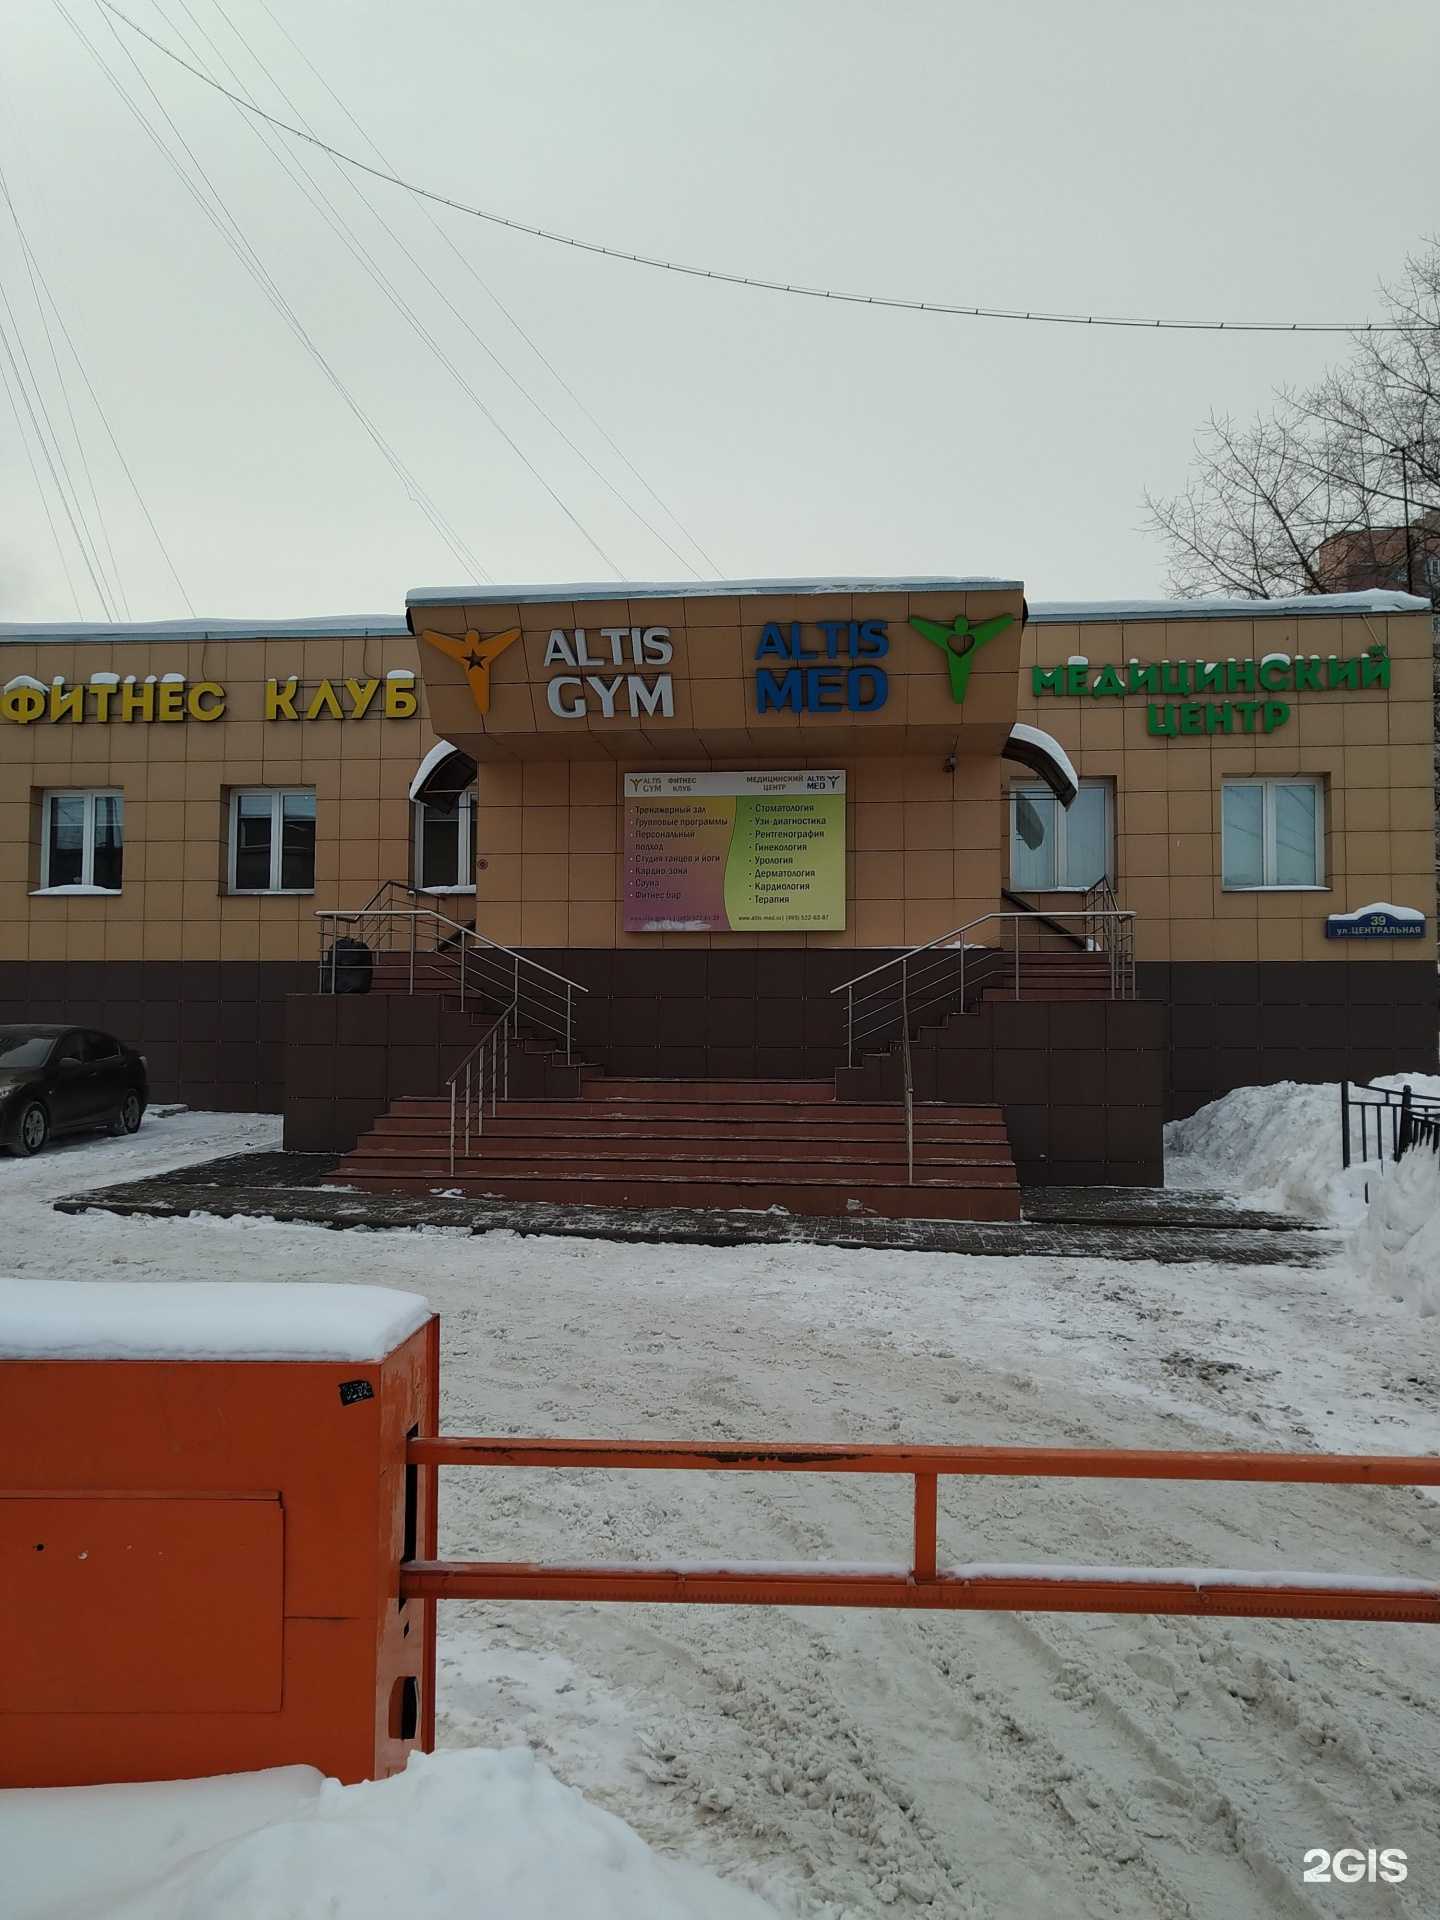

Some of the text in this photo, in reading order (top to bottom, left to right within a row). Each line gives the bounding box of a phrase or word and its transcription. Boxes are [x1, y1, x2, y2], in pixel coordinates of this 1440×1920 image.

[754, 619, 890, 661] ALTIS
[543, 626, 674, 668] ALTIS
[1032, 644, 1392, 699] МЕДИЦИНСКИЙ
[756, 666, 890, 714] MED
[1, 676, 419, 725] ФИТНЕС КЛУБ
[546, 672, 675, 719] GYM
[1146, 700, 1291, 738] ЦЕНТР
[807, 782, 826, 790] MED
[755, 803, 814, 813] Стоматология
[755, 830, 825, 840] Рентгенография
[755, 843, 807, 851] Гинекология
[754, 856, 794, 866] Урология
[754, 869, 816, 879] Дерматология
[754, 882, 810, 892] Кардиология
[754, 895, 790, 904] Терапия
[1370, 915, 1387, 926] 39
